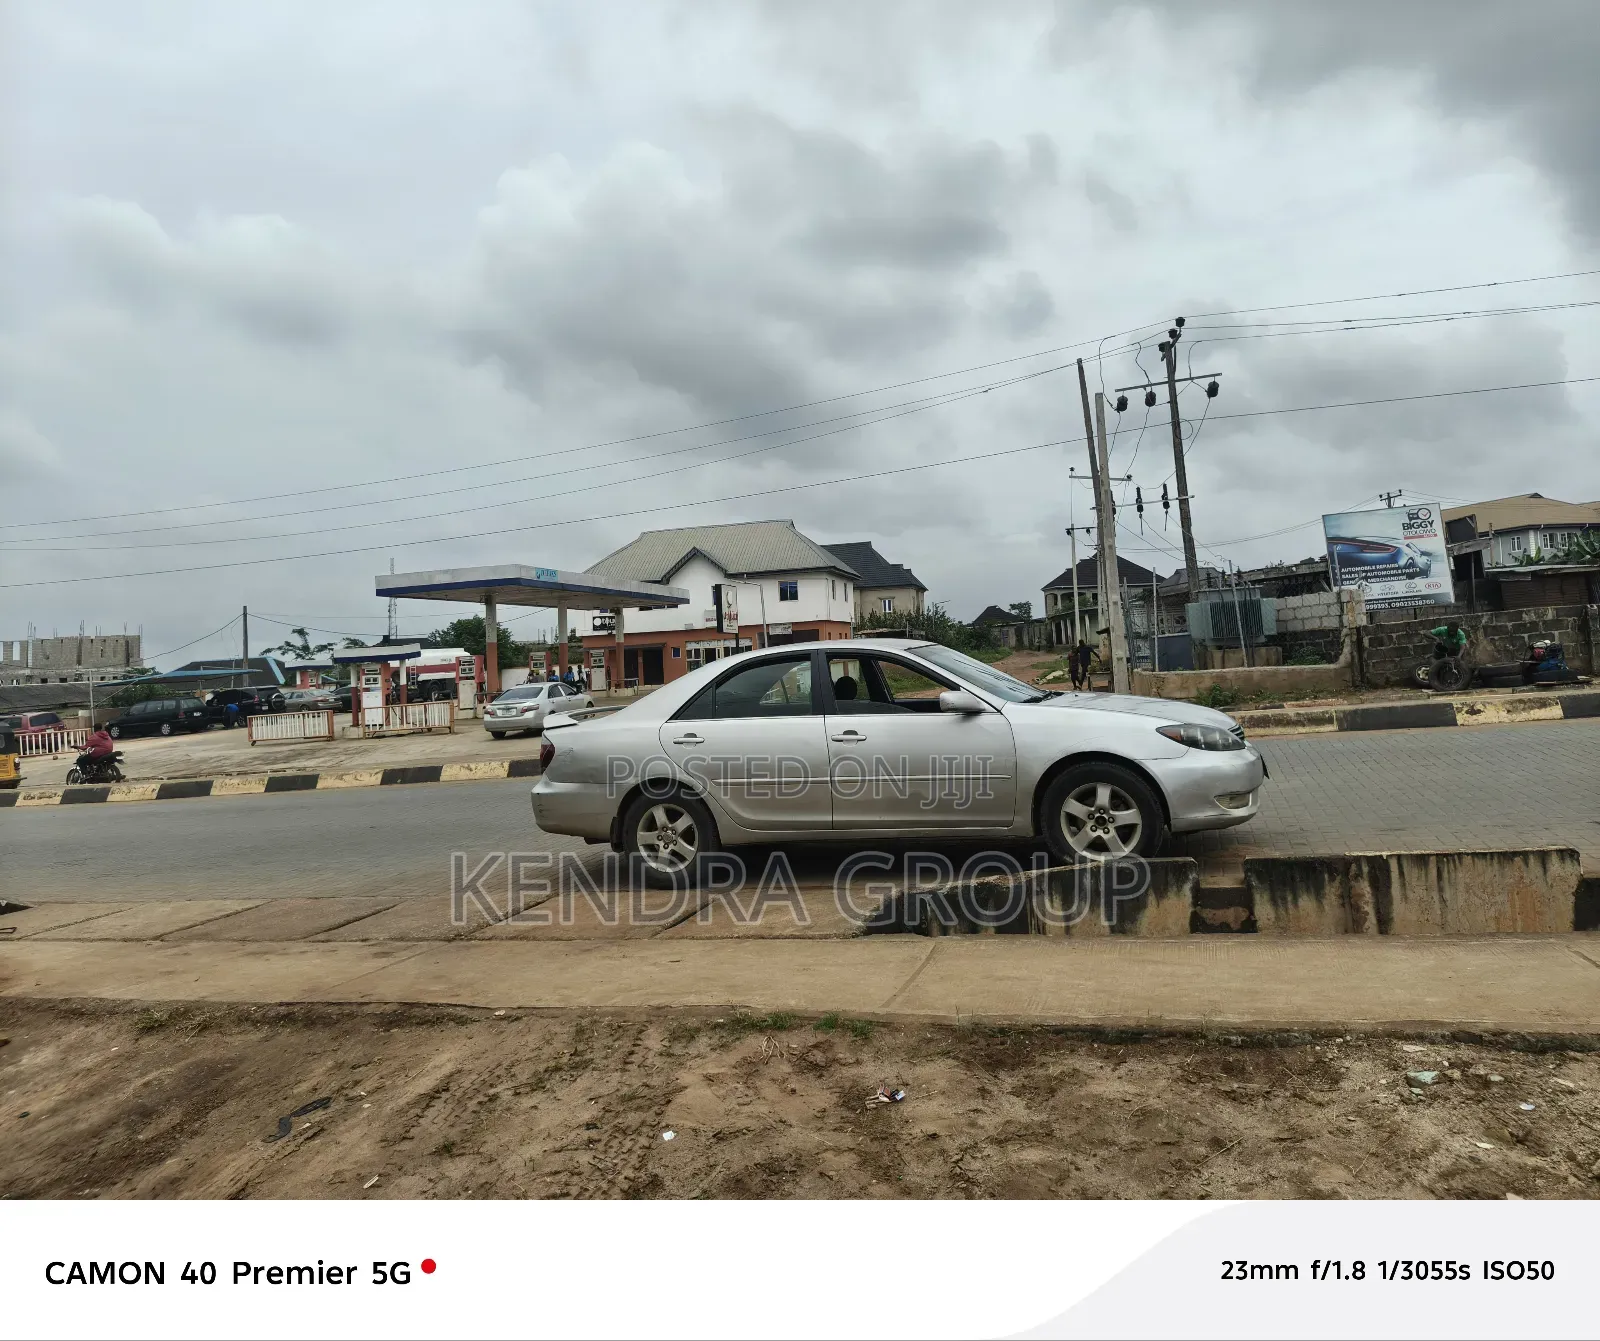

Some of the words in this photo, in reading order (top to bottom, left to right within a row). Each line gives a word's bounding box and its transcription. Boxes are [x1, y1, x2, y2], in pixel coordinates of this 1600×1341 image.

[1402, 520, 1434, 531] BIGGY
[1341, 564, 1376, 573] AUTOMOBILE
[1366, 569, 1402, 577] AUTOMOBILE
